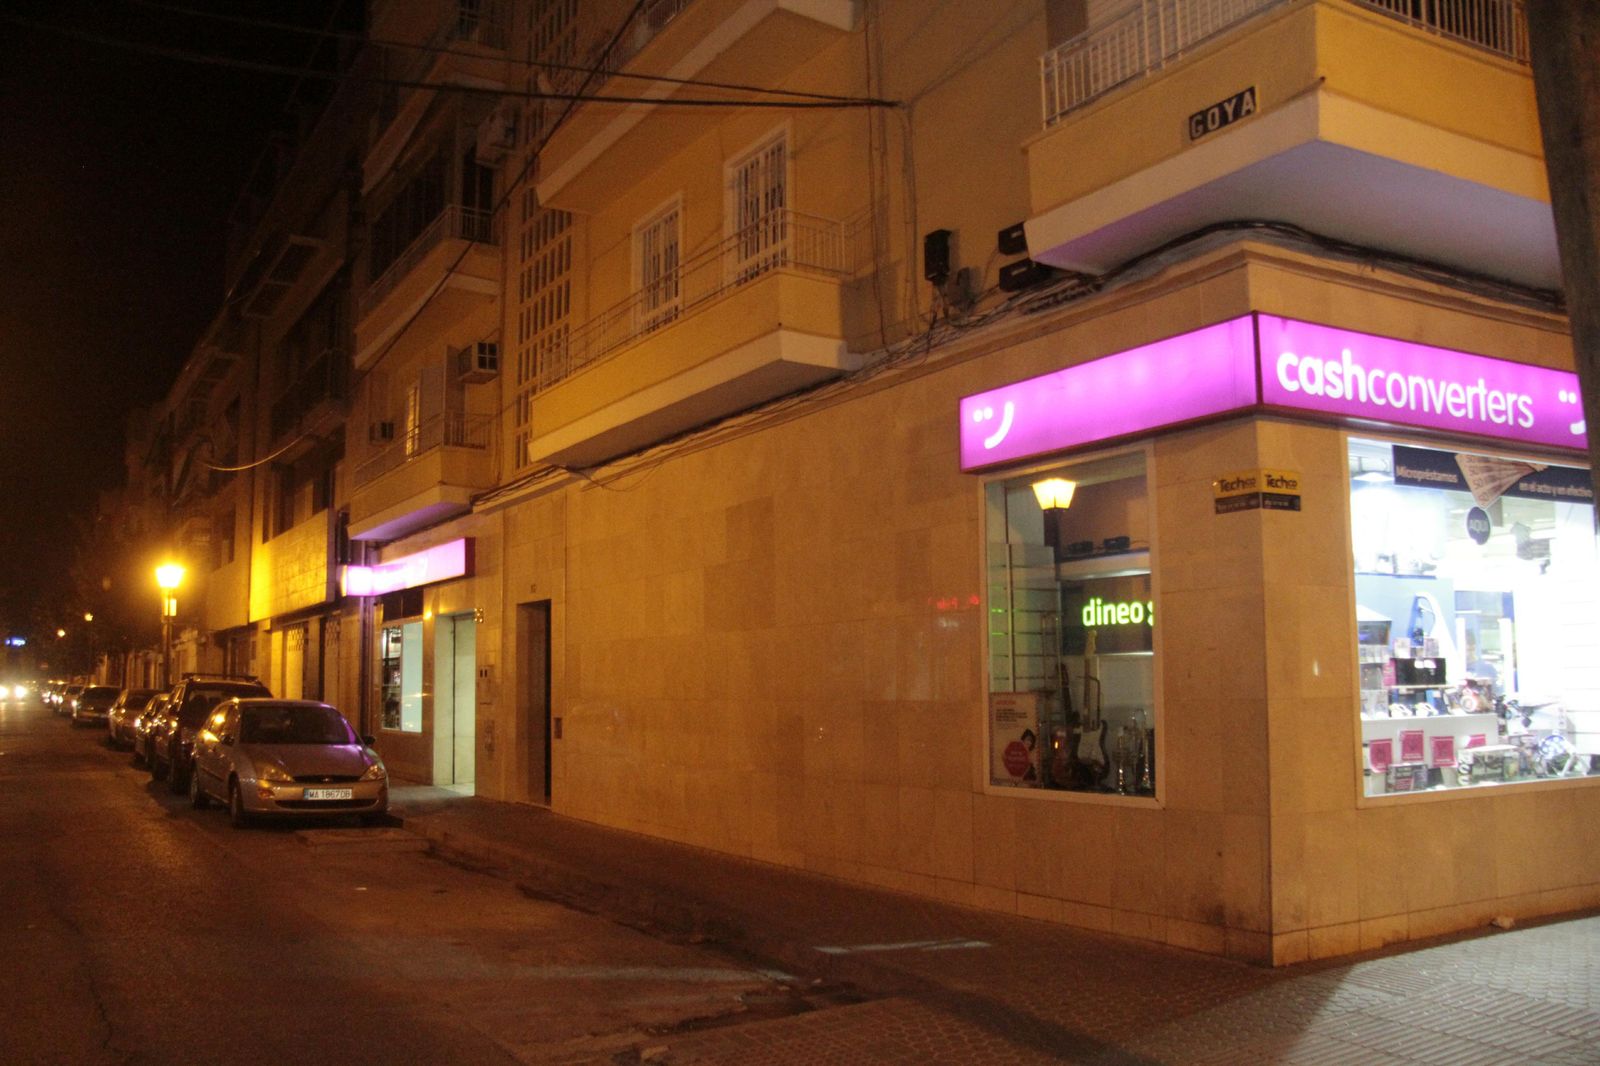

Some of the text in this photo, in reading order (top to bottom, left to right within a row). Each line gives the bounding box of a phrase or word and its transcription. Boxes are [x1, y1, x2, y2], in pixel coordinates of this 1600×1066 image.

[1190, 90, 1255, 138] GOYA
[1276, 348, 1534, 429] cashconverters
[1082, 597, 1144, 627] dineo
